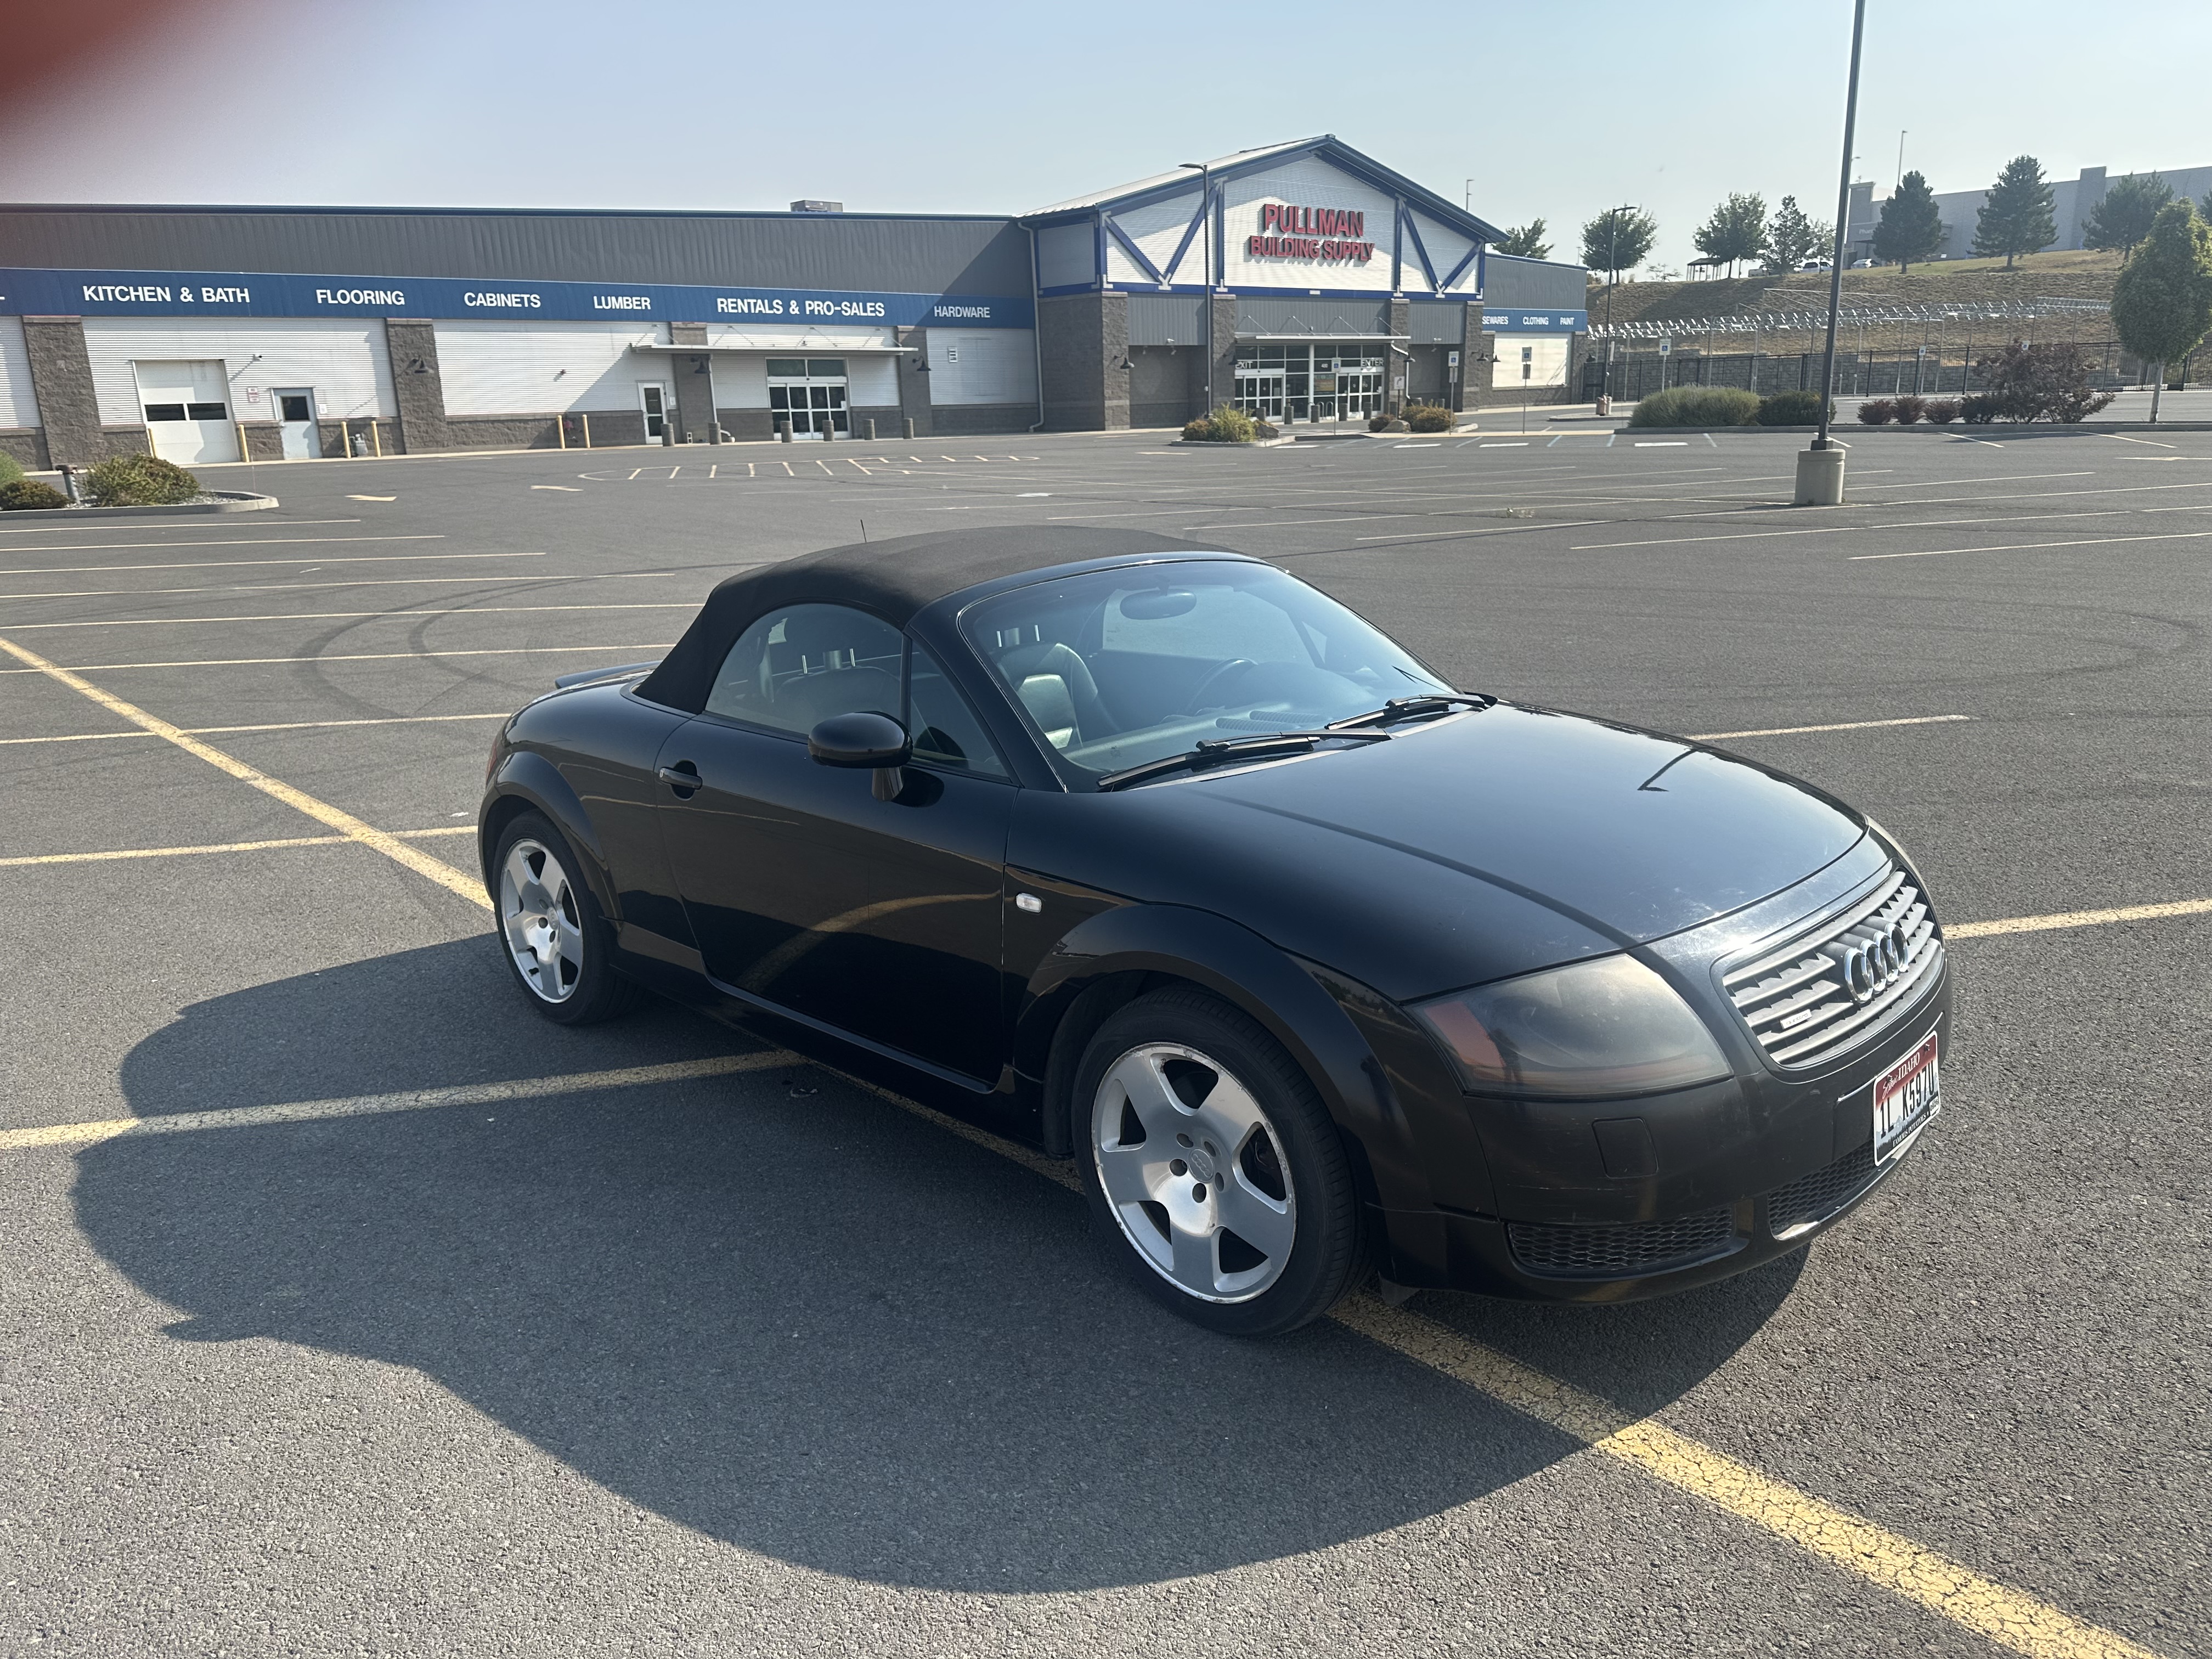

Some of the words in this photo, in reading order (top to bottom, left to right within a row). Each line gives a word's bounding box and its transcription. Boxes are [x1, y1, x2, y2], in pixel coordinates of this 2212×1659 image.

[1265, 204, 1364, 238] PULLMAN
[1250, 235, 1321, 259] BUILDING
[1323, 240, 1375, 261] SUPPLY
[82, 285, 172, 302] KITCHEN
[179, 286, 194, 302] &
[201, 287, 250, 303] BATH
[316, 289, 405, 306] FLOORING
[464, 292, 541, 308] CABINETS
[593, 295, 651, 310] LUMBER
[716, 298, 783, 314] RENTALS
[789, 300, 800, 314] &
[805, 300, 885, 317] PRO-SALES
[934, 306, 991, 318] HARDWARE
[1522, 316, 1549, 325] CLOTHING
[1559, 317, 1575, 325] PAINT
[1361, 358, 1384, 366] ENTER
[1897, 1052, 1920, 1082] IDAHO
[1880, 1097, 1894, 1139] 1L
[1902, 1060, 1934, 1121] K597U
[1893, 1130, 1908, 1148] FAMOUS
[1908, 1113, 1926, 1134] POTATOES
